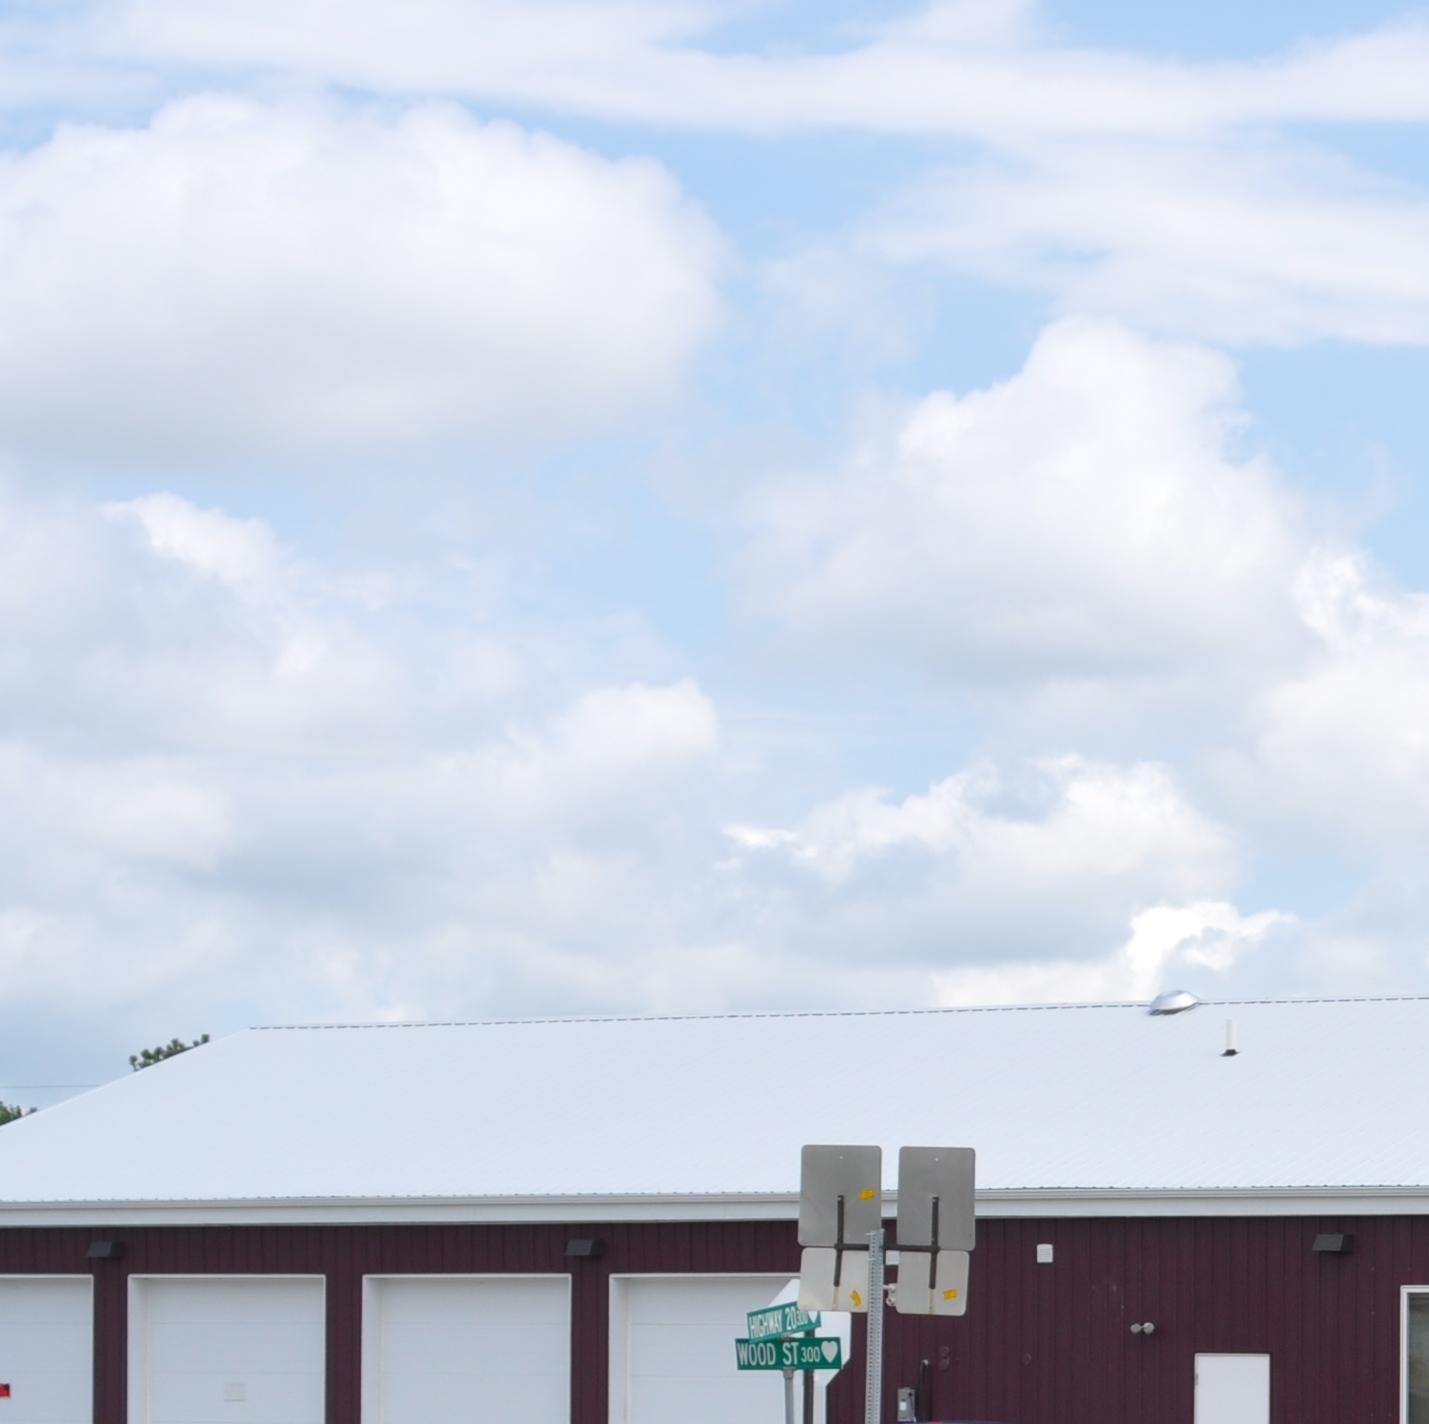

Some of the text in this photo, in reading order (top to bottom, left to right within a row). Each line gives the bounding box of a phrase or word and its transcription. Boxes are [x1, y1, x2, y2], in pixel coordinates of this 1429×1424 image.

[749, 1310, 783, 1339] HIGHWAY
[785, 1306, 797, 1331] 20
[737, 1342, 820, 1366] WOOD ST 300
